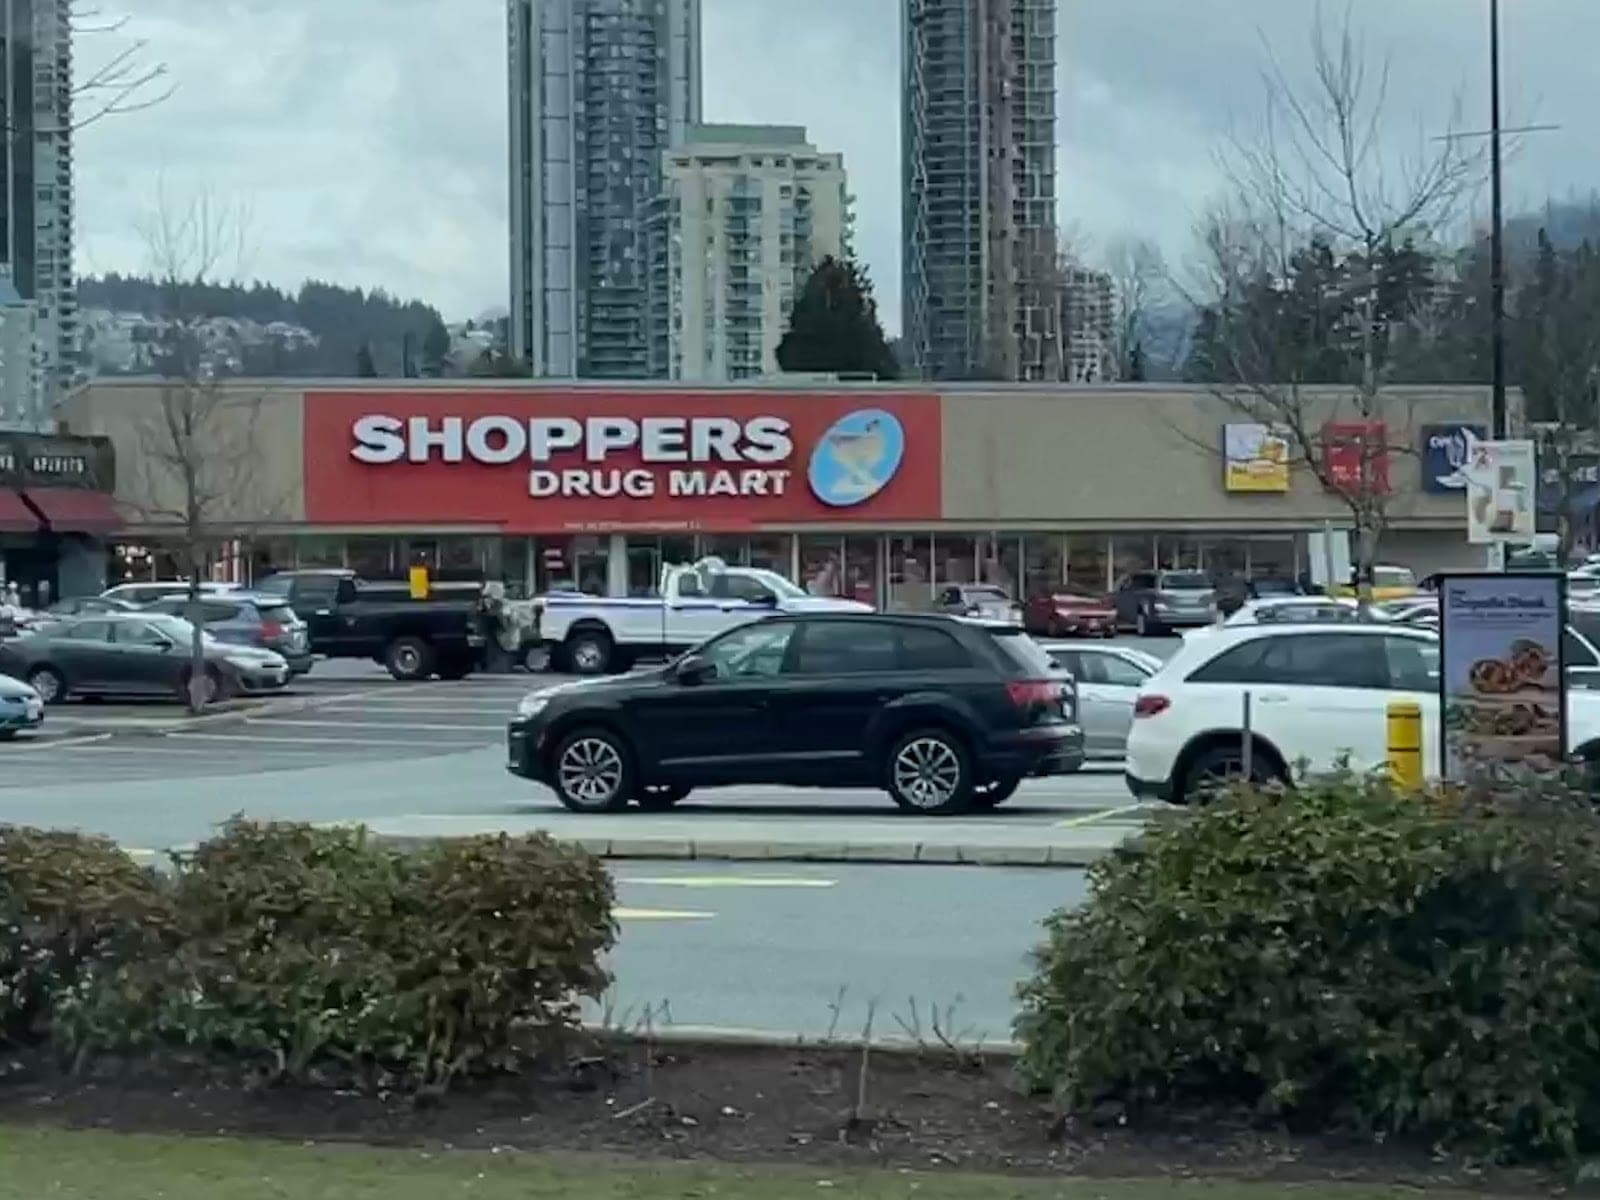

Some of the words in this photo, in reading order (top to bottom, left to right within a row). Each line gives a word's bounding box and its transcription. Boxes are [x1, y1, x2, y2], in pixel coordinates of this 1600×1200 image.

[350, 414, 793, 464] SHOPPERS
[529, 469, 655, 497] DRUG
[668, 469, 790, 497] MART
